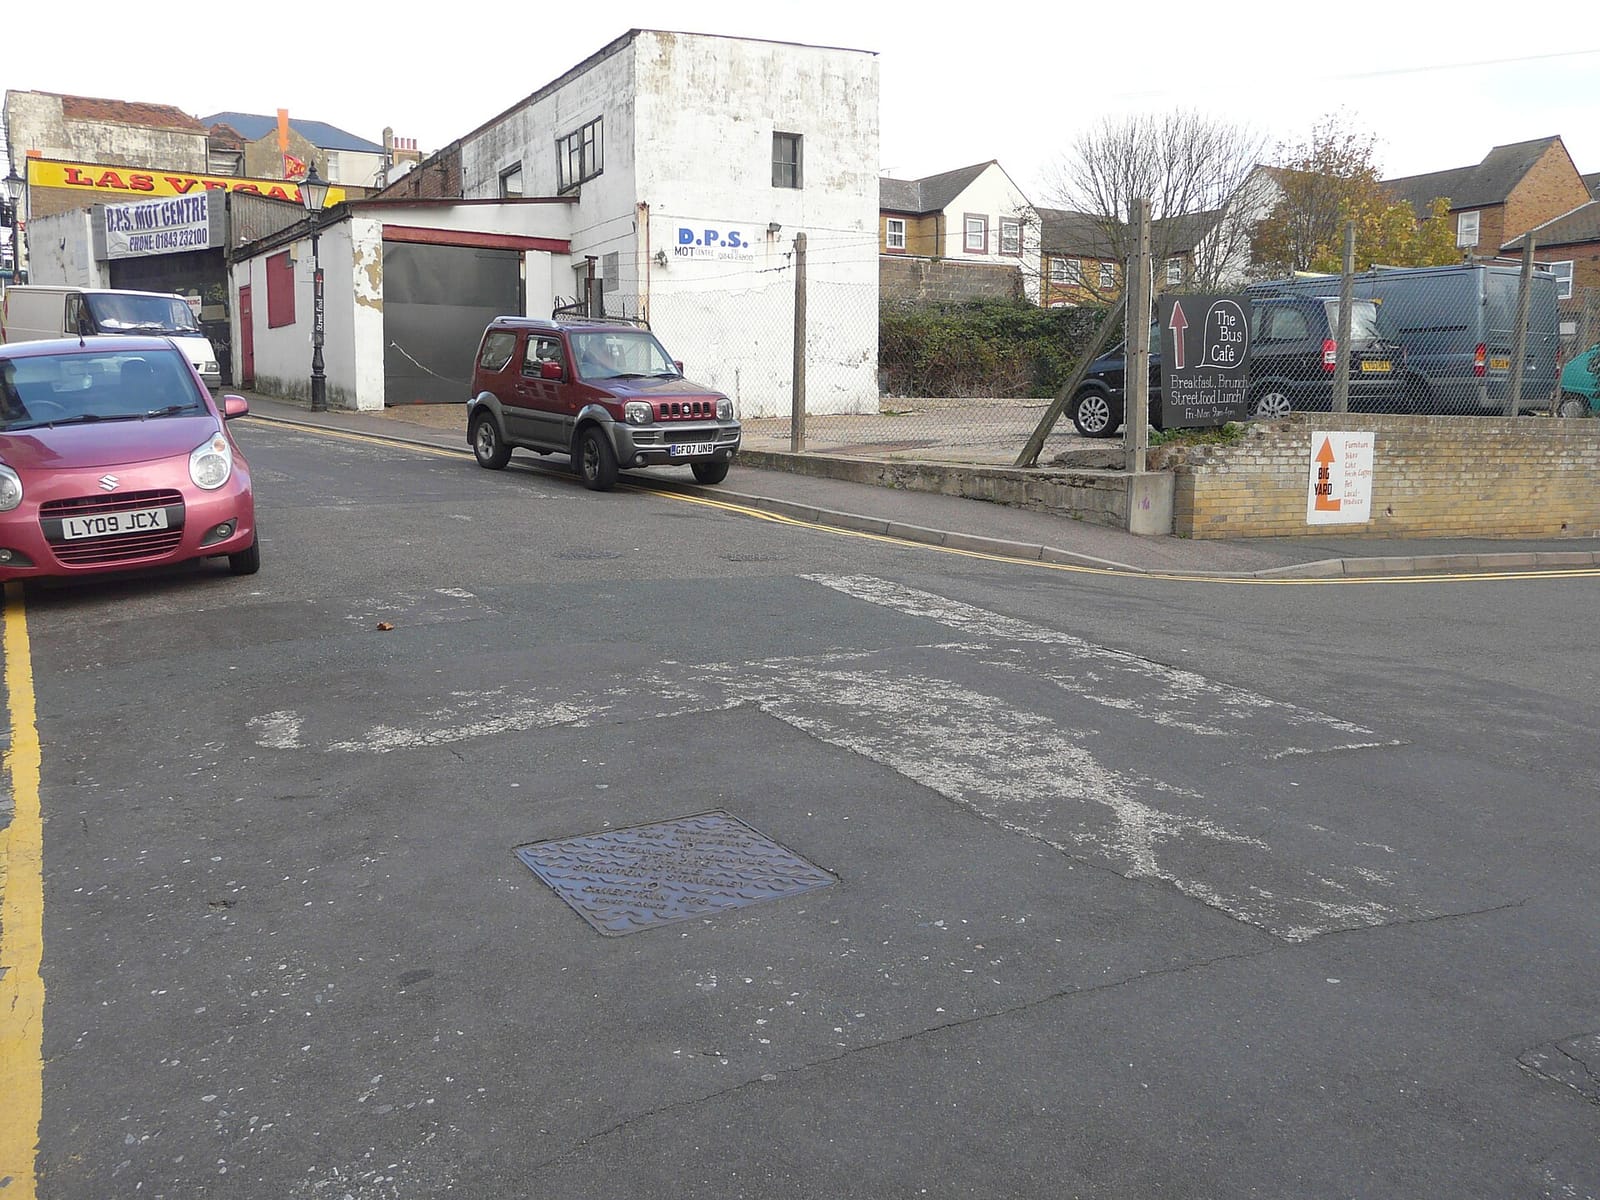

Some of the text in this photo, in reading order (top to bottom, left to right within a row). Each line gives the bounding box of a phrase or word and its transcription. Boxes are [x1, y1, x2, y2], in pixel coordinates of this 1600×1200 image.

[64, 168, 154, 191] LAS
[106, 196, 207, 232] D.P.S. MOT CENTRE
[155, 231, 178, 250] 01843
[179, 228, 208, 246] 232100
[679, 228, 749, 248] D.P.S.
[674, 246, 695, 257] MOT
[1215, 310, 1236, 326] The
[1220, 326, 1242, 342] Bus
[1211, 344, 1235, 362] Café
[1217, 388, 1246, 404] Lunch!
[676, 444, 696, 455] GF07
[1318, 467, 1330, 480] BIG
[1314, 483, 1333, 496] YARD
[69, 511, 160, 537] LY09 JCX
